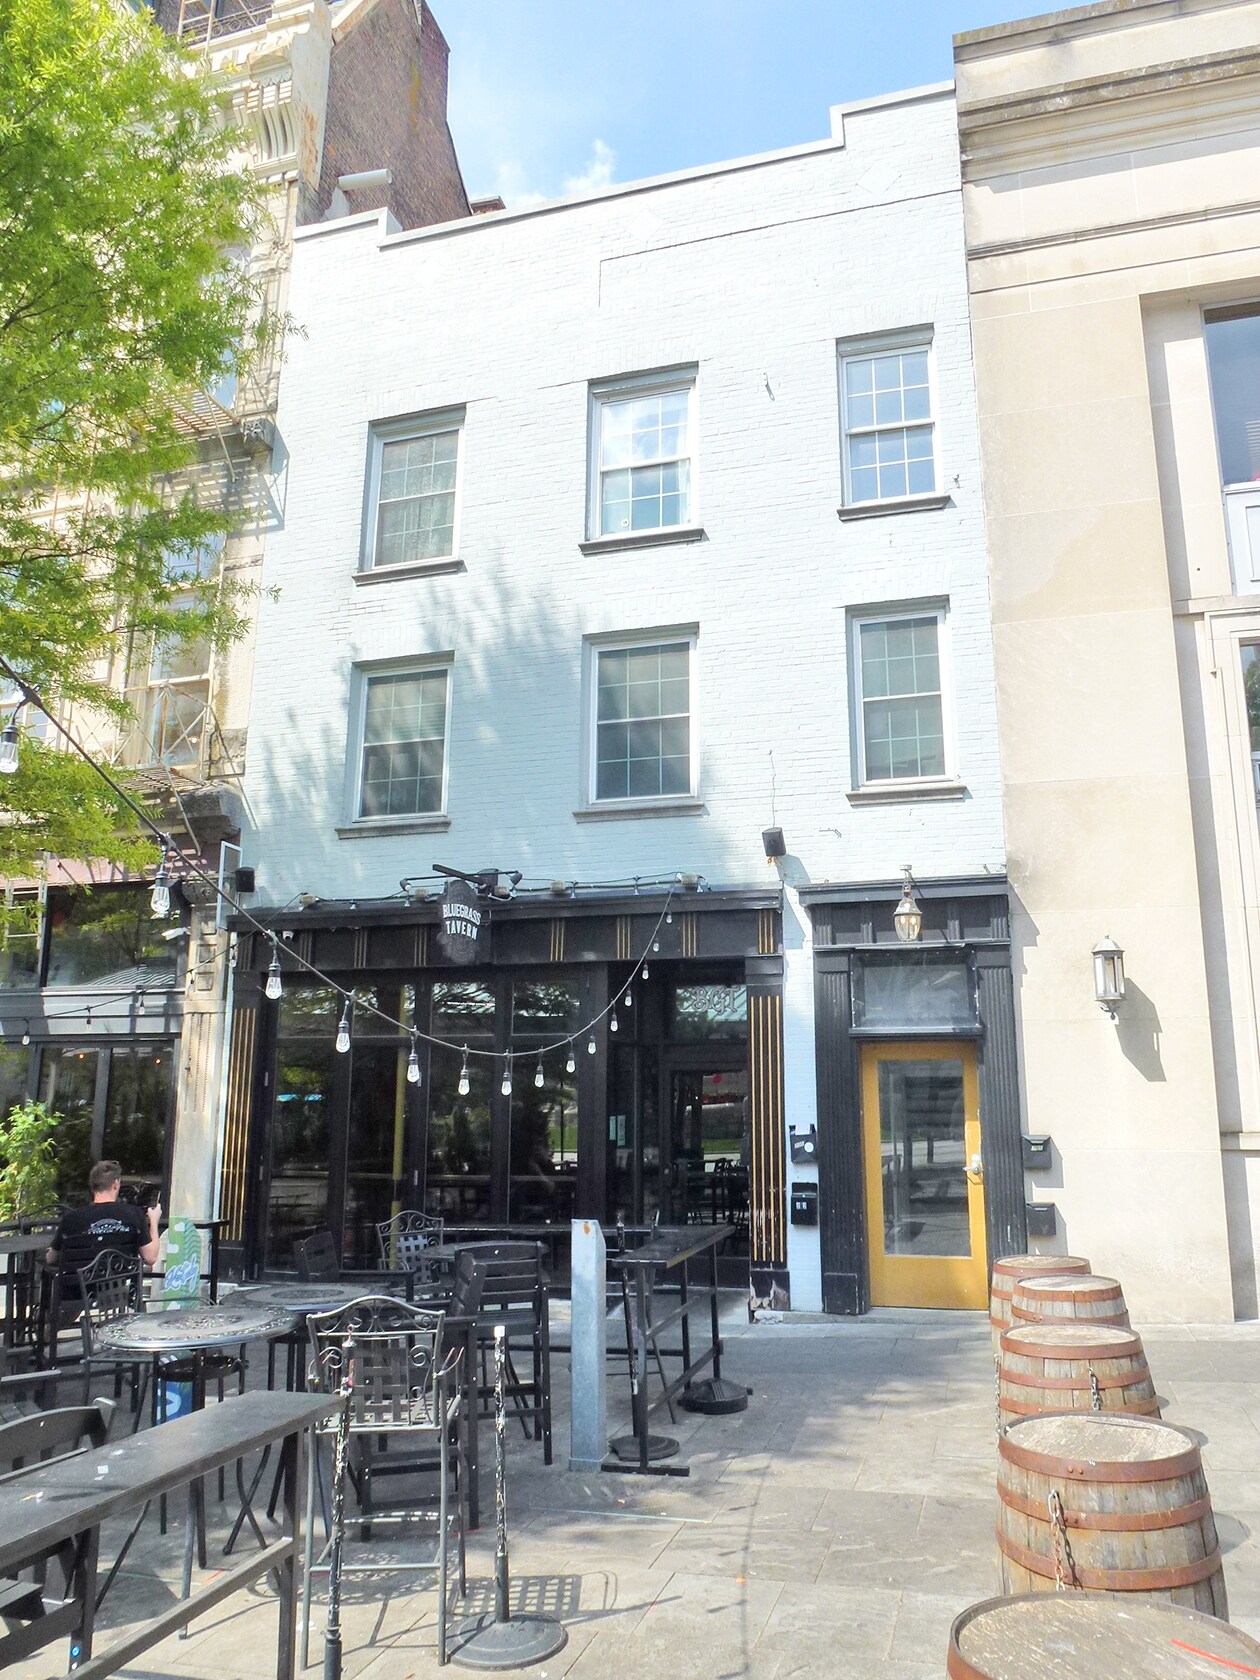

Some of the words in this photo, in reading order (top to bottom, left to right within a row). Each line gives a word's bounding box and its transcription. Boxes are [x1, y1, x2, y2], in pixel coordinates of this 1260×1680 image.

[442, 903, 481, 926] BLUEGRASS
[445, 919, 478, 940] TAVERN
[691, 985, 741, 1016] BGT
